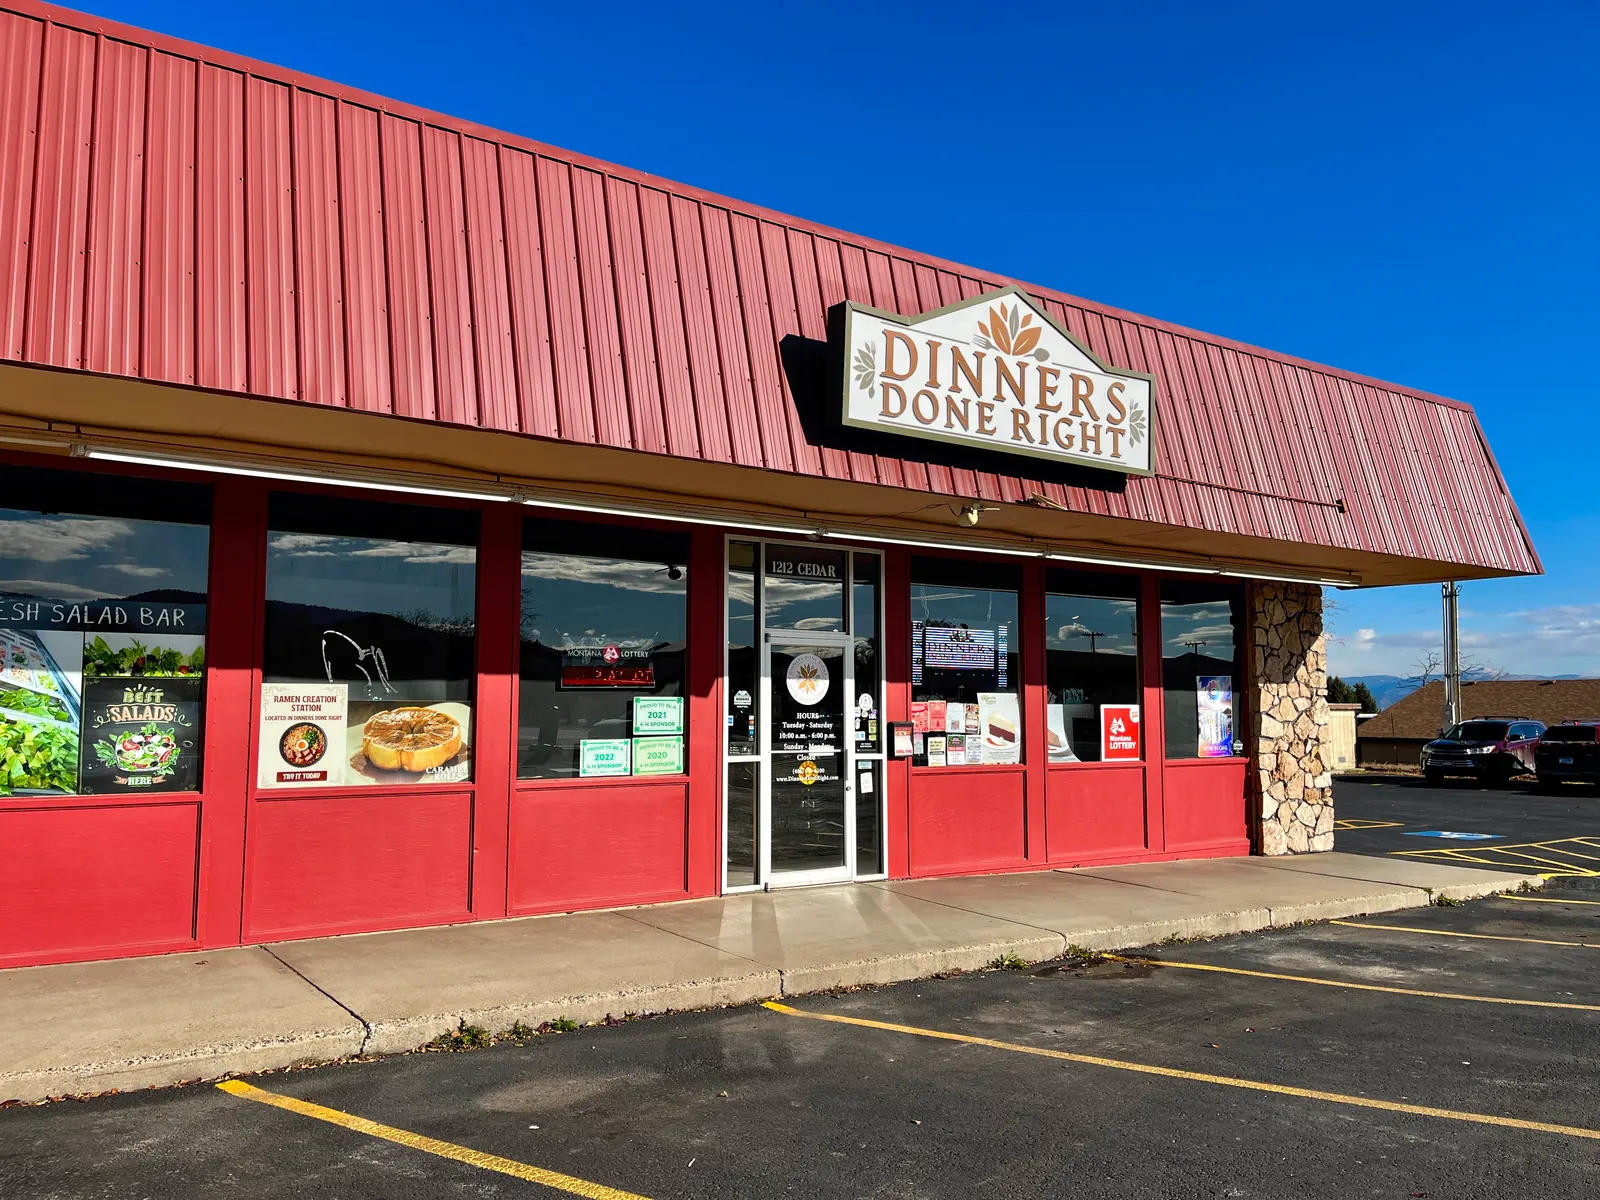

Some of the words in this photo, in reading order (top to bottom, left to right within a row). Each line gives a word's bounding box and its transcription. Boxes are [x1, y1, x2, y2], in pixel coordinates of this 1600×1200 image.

[880, 328, 1127, 426] DINNERS
[879, 381, 997, 436] DONE
[1011, 407, 1126, 458] RIGHT
[772, 561, 793, 574] 1212
[797, 562, 836, 577] CEDAR
[51, 604, 127, 625] SALAD
[140, 607, 185, 627] BAR
[568, 650, 602, 658] MONTANA
[122, 690, 164, 703] BEST
[274, 695, 300, 703] RAMEN
[302, 695, 337, 703] CREATION
[291, 704, 322, 712] STATION
[109, 705, 175, 722] SALADS
[648, 711, 667, 719] 2021
[782, 721, 805, 730] Tuesday
[809, 721, 834, 730] Saturday
[784, 743, 805, 751] Sunday
[594, 753, 615, 761] 2022
[647, 751, 668, 760] 2020
[425, 766, 468, 774] CARAMEL
[128, 776, 152, 786] HERE
